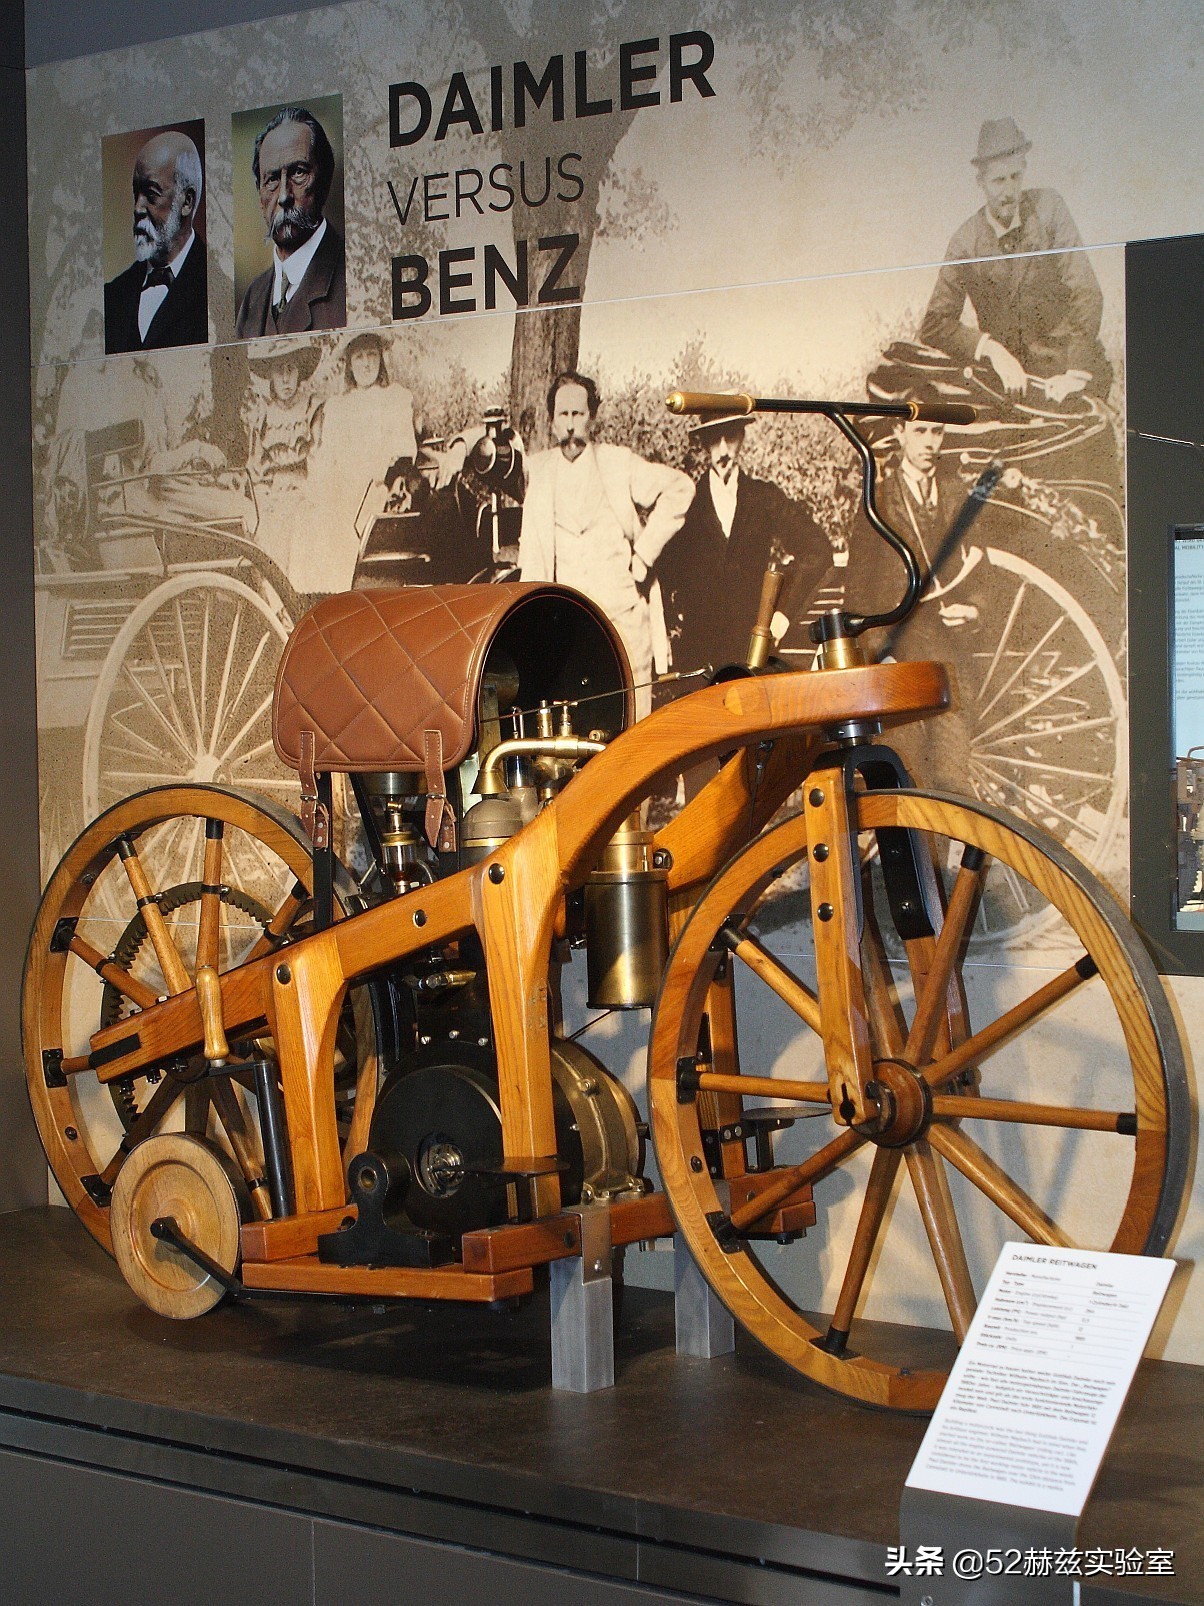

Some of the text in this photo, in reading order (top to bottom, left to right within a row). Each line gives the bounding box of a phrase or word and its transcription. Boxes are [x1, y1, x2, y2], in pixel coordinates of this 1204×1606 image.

[389, 30, 716, 148] DAIMLER
[388, 153, 585, 226] VERSUS
[392, 234, 581, 320] BENZ
[1012, 1254, 1098, 1270] DAIMLER REITWAGEN
